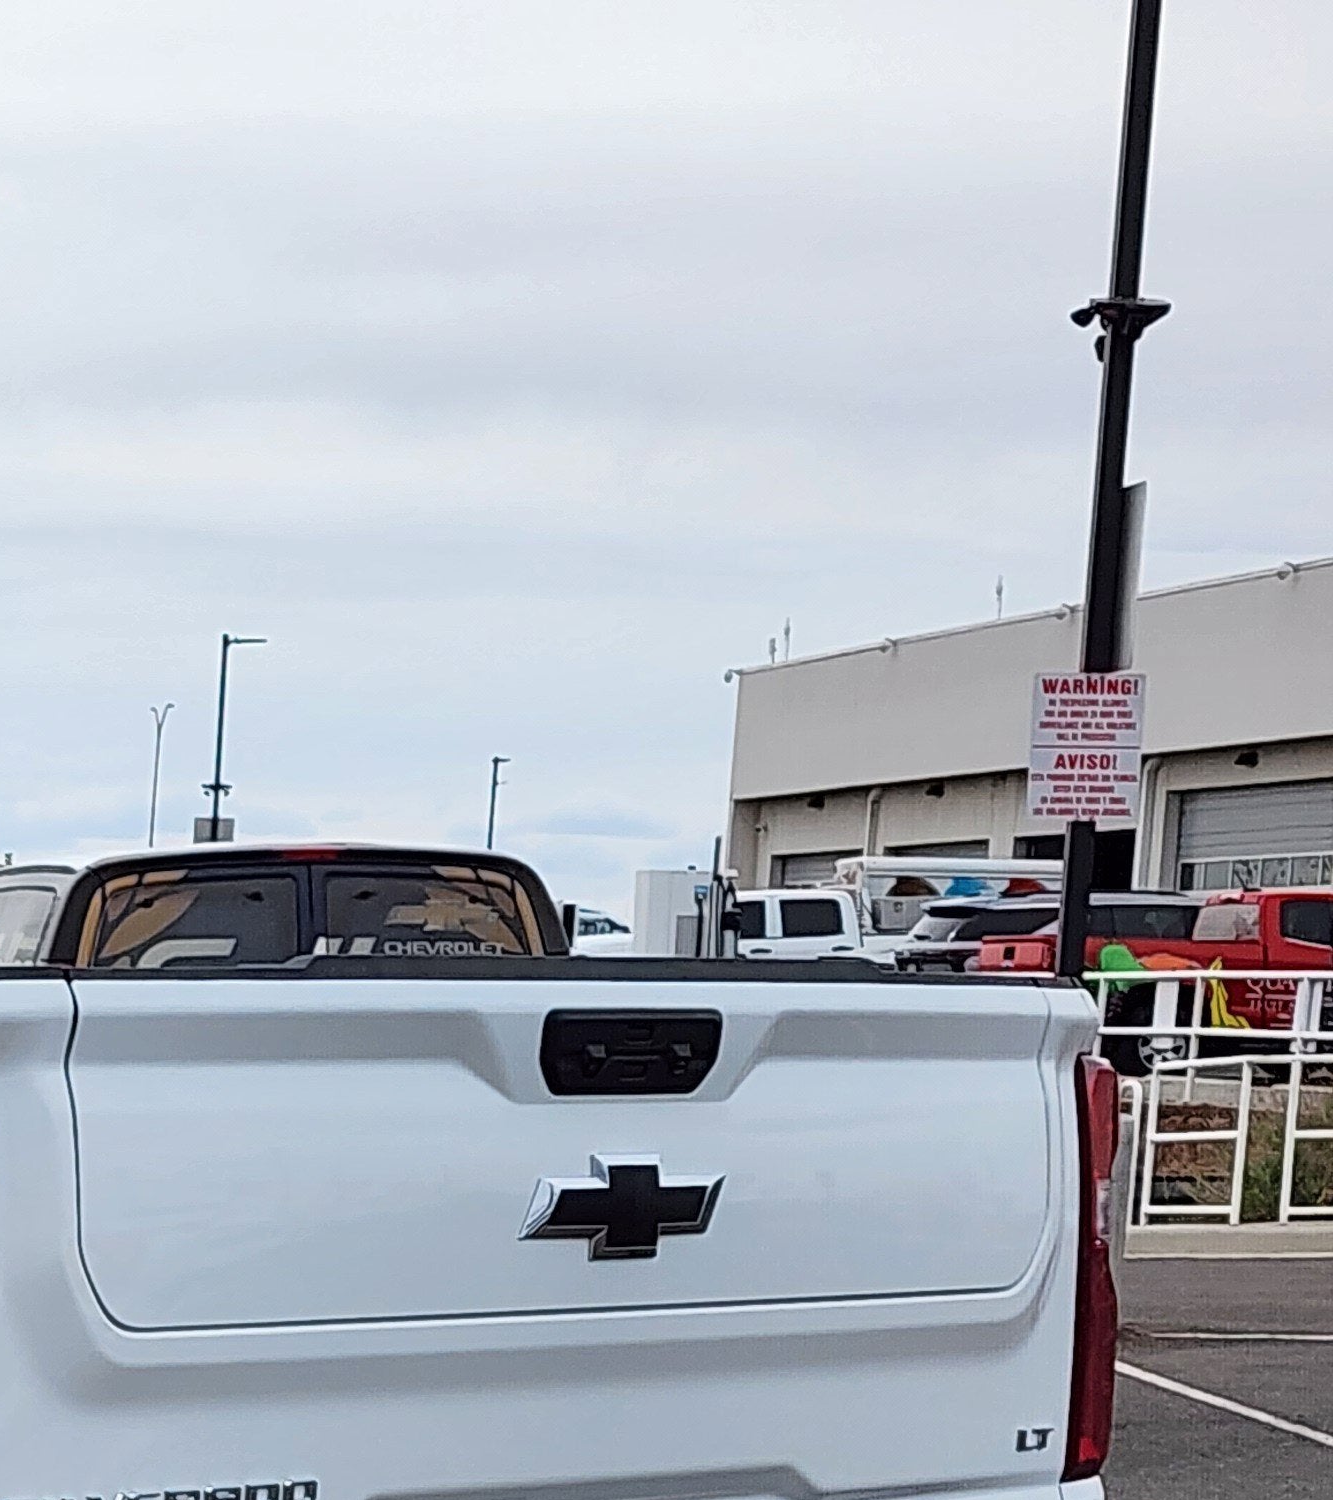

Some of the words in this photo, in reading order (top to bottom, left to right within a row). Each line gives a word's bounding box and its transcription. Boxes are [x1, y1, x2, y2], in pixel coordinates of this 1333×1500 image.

[1041, 676, 1139, 696] WARNING!
[1053, 753, 1118, 770] AVISO!
[383, 940, 506, 957] CHEVROLET
[1015, 1427, 1055, 1453] LT
